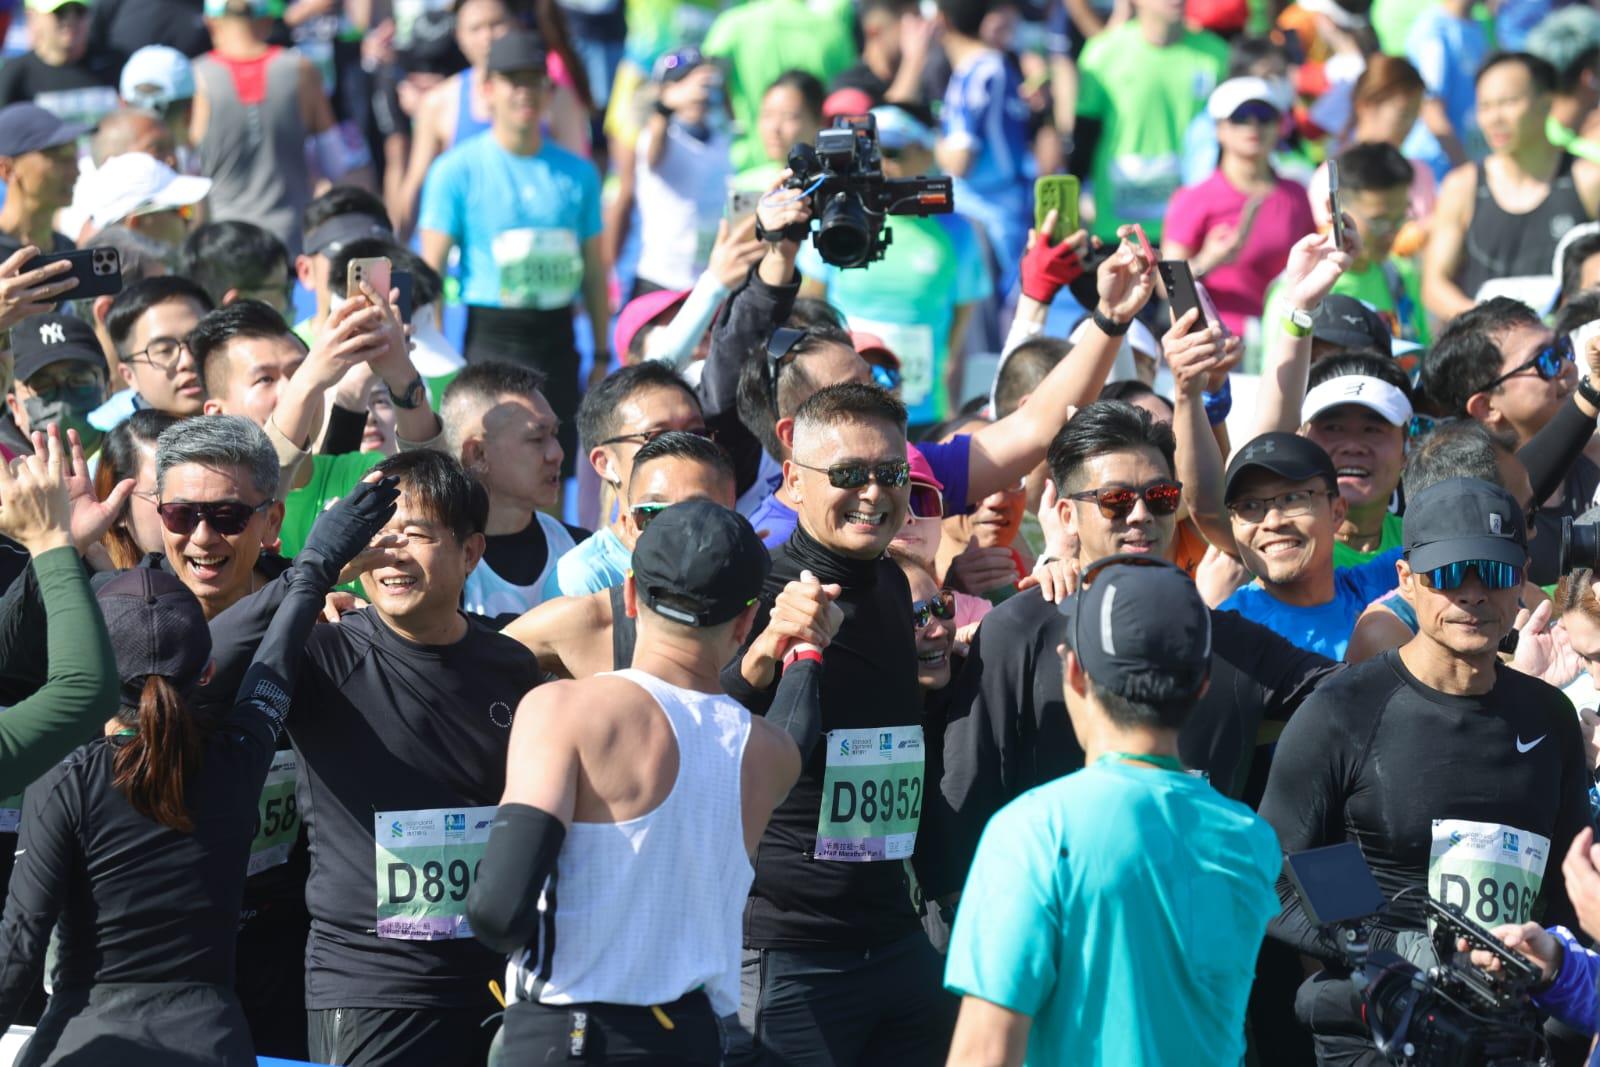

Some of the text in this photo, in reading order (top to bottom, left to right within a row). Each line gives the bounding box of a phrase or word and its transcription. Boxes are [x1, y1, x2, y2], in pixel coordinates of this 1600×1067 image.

[254, 794, 297, 837] 58
[830, 777, 920, 823] D8952
[388, 859, 483, 904] D89
